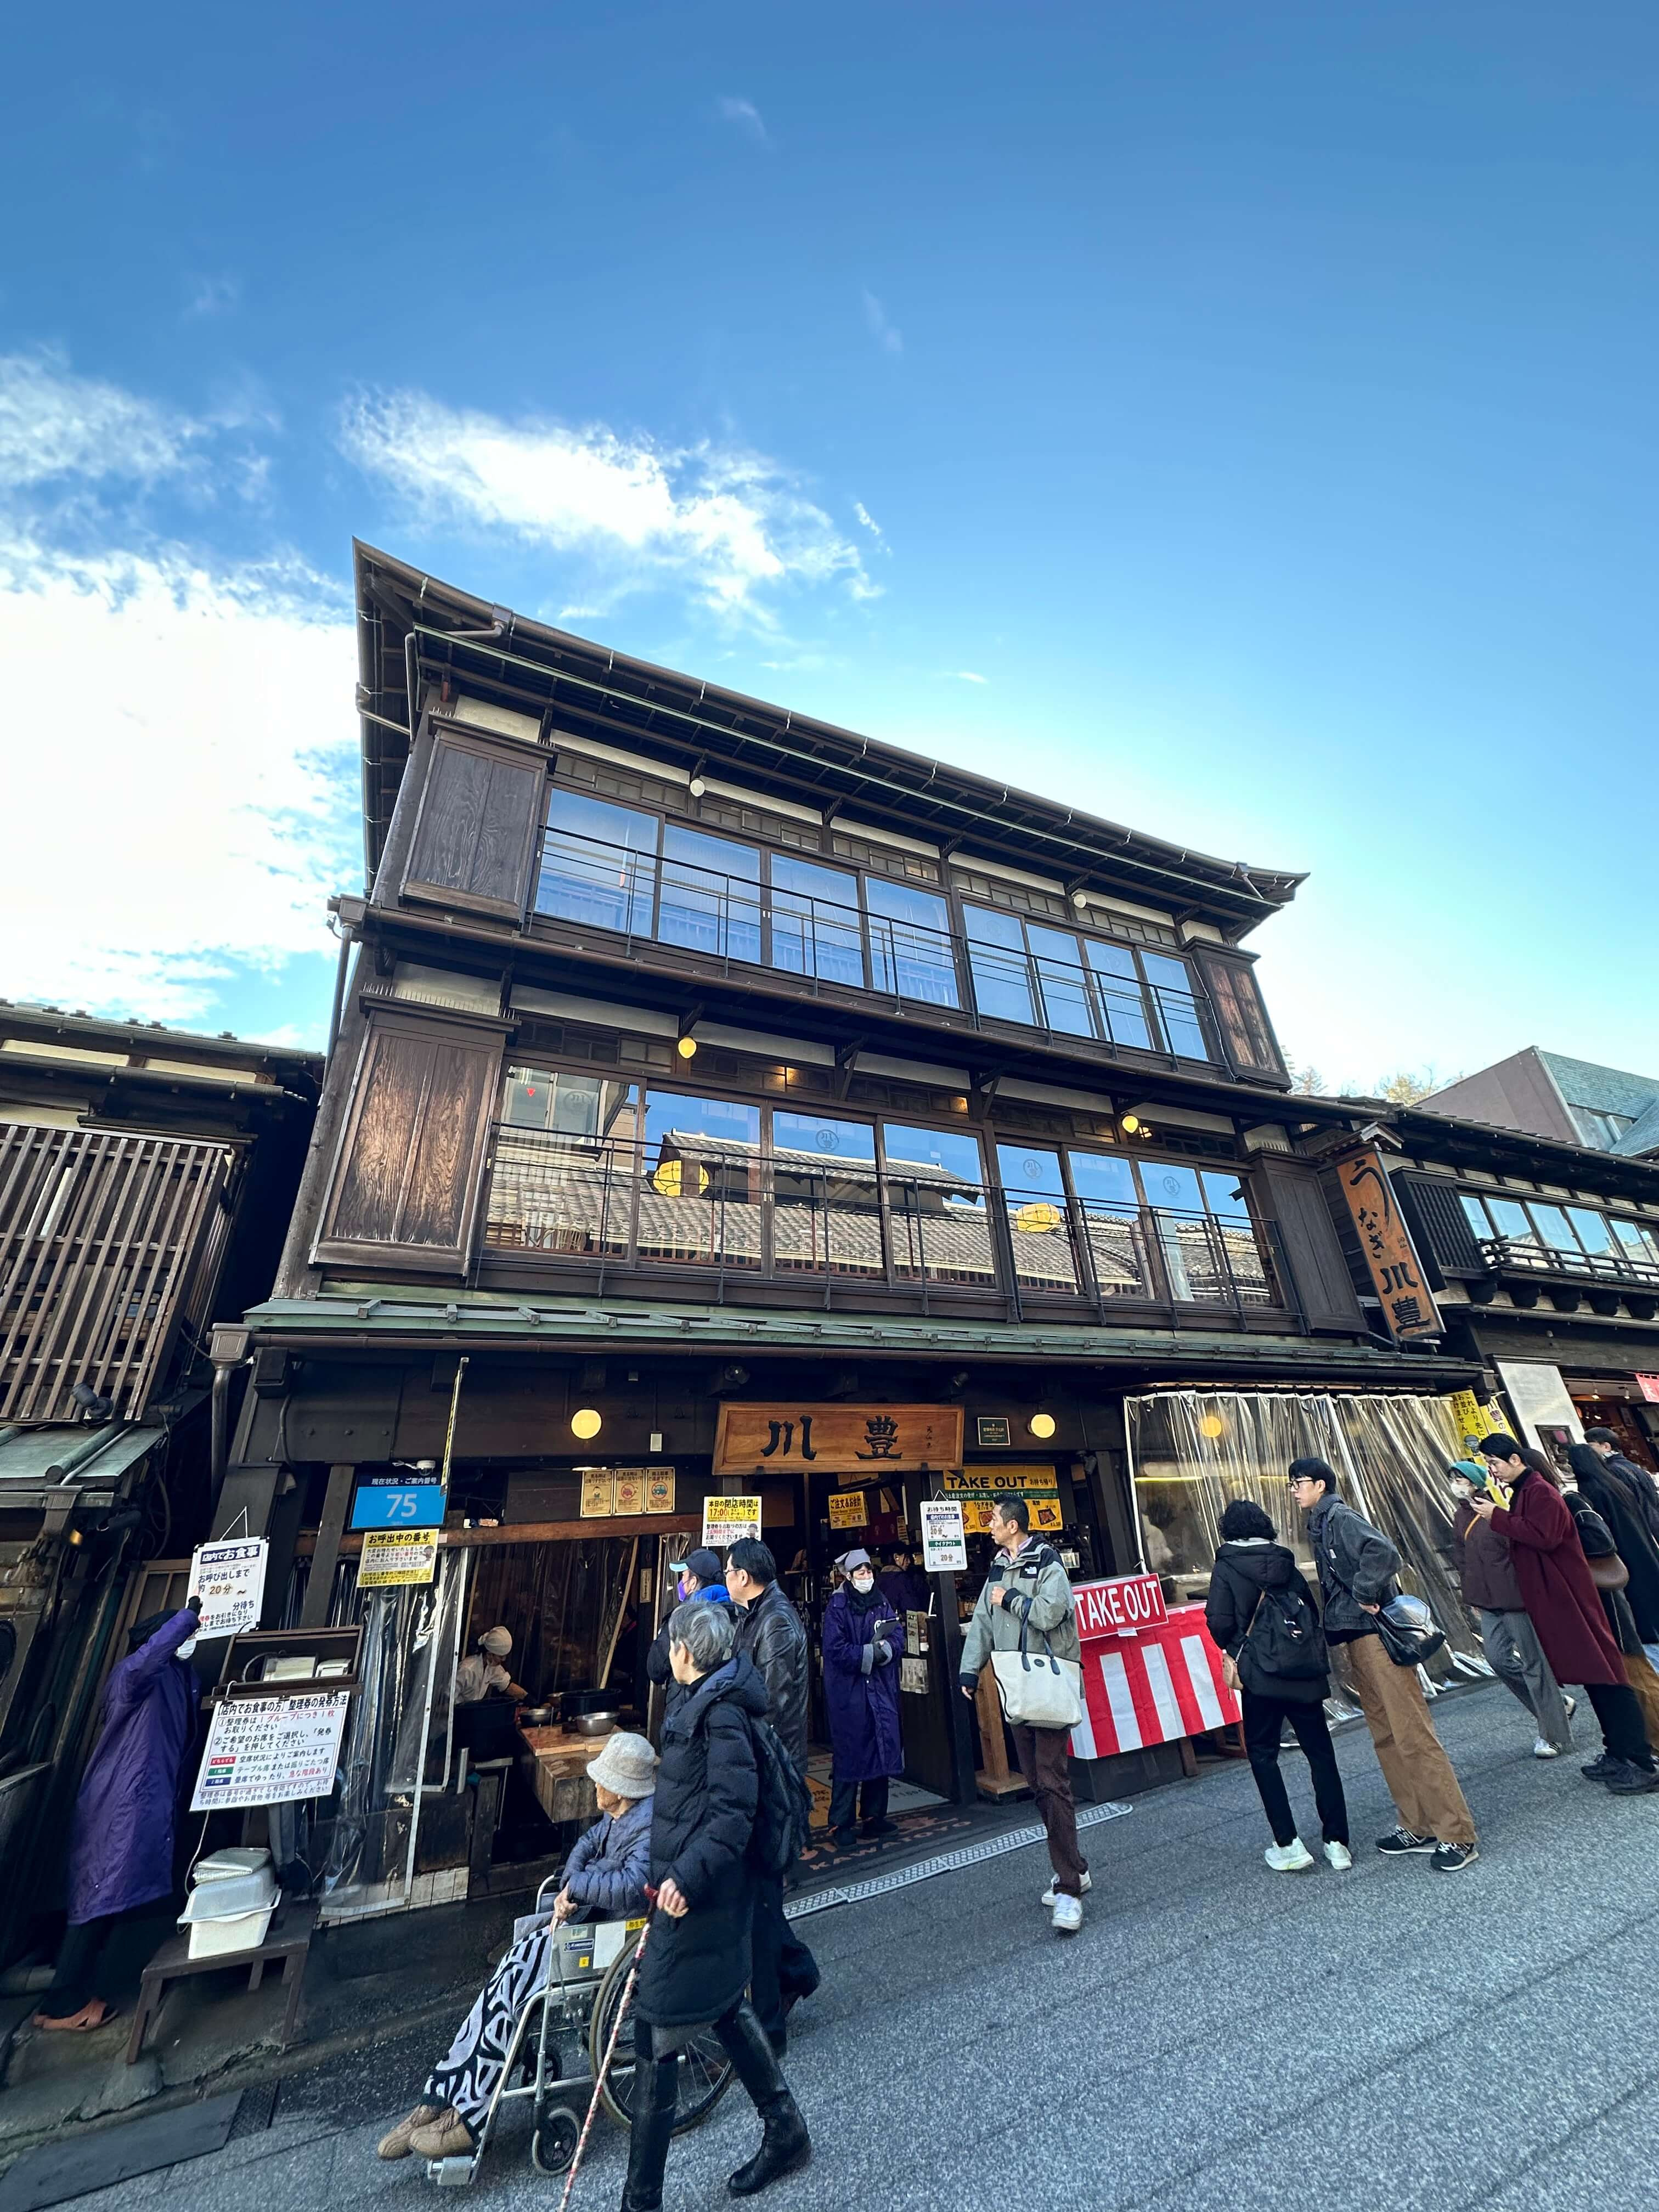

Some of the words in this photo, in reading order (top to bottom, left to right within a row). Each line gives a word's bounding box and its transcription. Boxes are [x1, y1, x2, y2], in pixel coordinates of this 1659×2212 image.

[760, 1415, 902, 1460] 川豊
[946, 1476, 990, 1489] TAKE
[994, 1476, 1027, 1488] OUT
[386, 1493, 417, 1518] 75
[708, 1499, 759, 1508] 本日の閉店時間は
[369, 1532, 430, 1544] お呼出中の番号
[201, 1545, 259, 1562] 店内でお食事
[198, 1568, 250, 1584] お呼び出しまで
[233, 1600, 255, 1611] 分待ち
[1073, 1587, 1126, 1631] TAKE
[1124, 1580, 1160, 1621] OUT
[224, 1723, 278, 1734] お取りください
